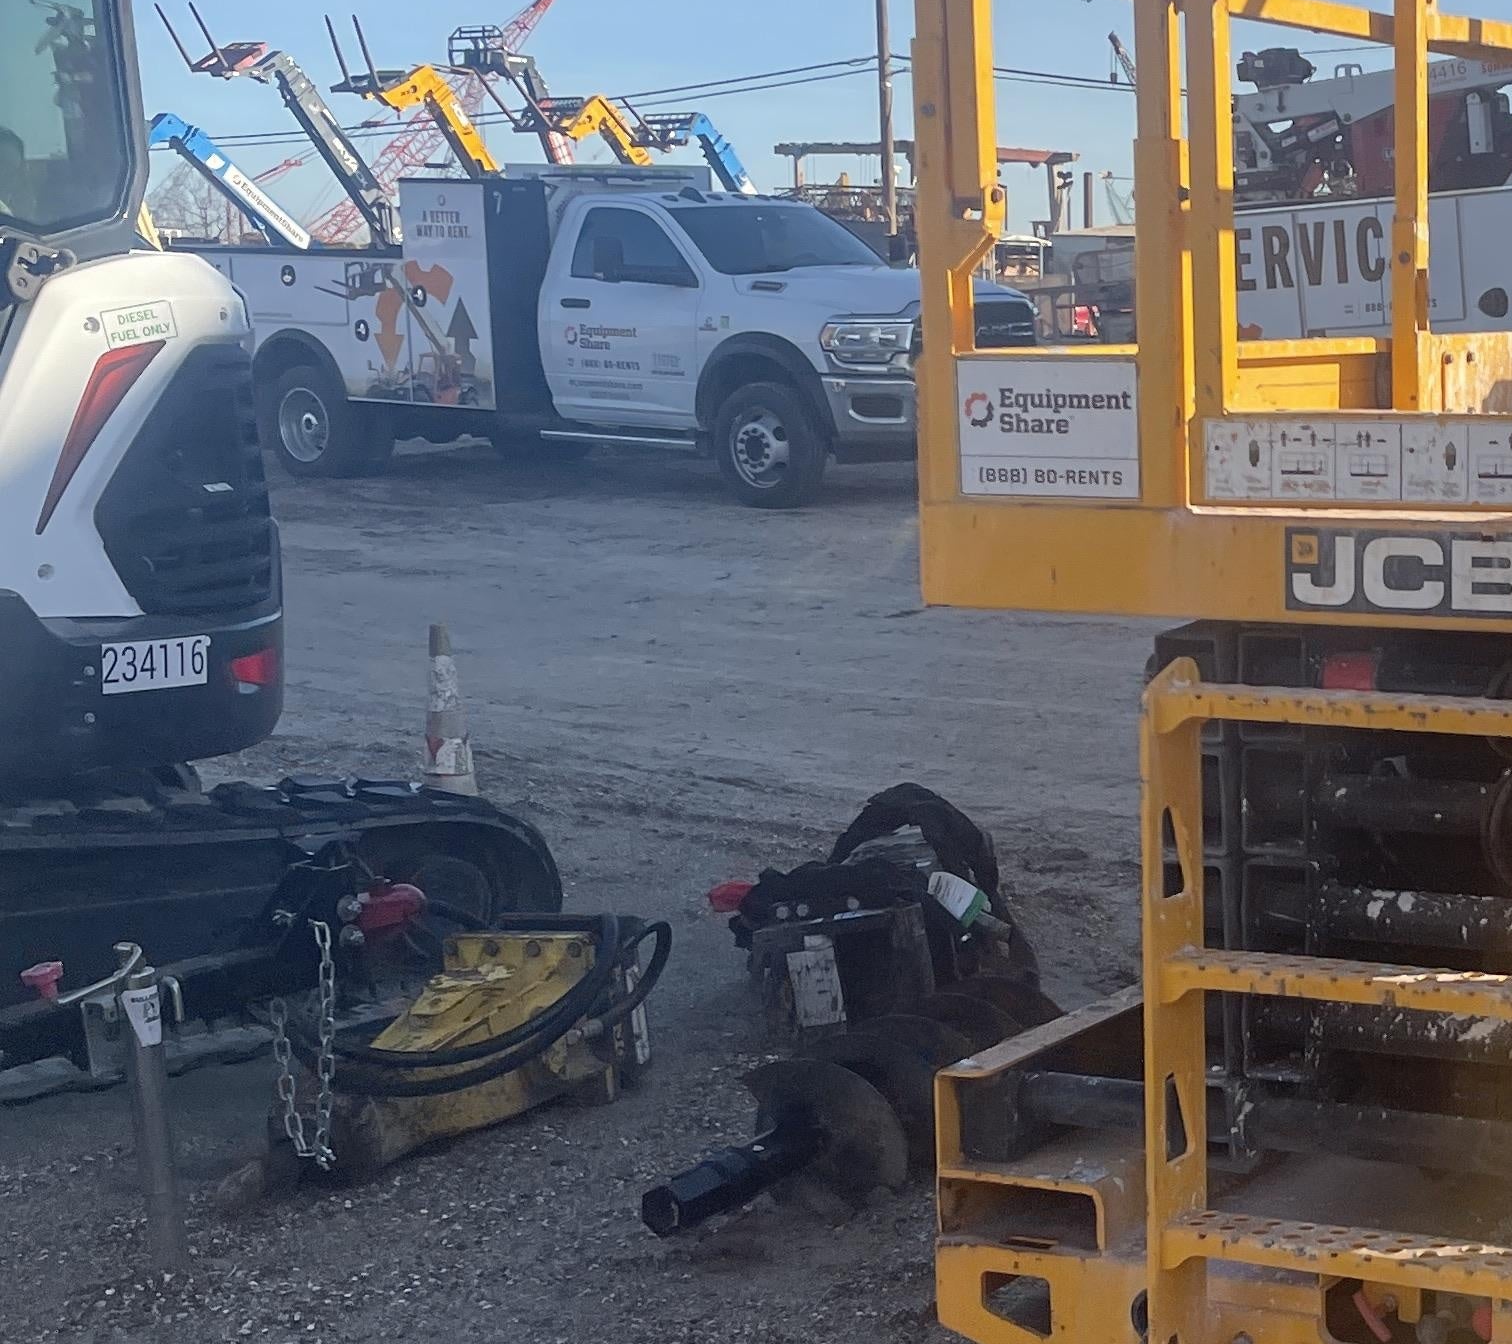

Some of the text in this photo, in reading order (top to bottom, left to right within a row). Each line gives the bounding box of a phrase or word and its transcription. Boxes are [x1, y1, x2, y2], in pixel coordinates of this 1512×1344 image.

[429, 210, 460, 224] BETTER
[117, 309, 158, 325] DIESEL
[111, 321, 170, 342] FUEL ONLY
[579, 324, 637, 339] Equipment
[579, 339, 611, 350] Share
[999, 388, 1132, 414] Equipment
[1000, 413, 1069, 434] Share
[979, 467, 1123, 486] (888) 80-RENTS
[103, 639, 204, 683] 234116
